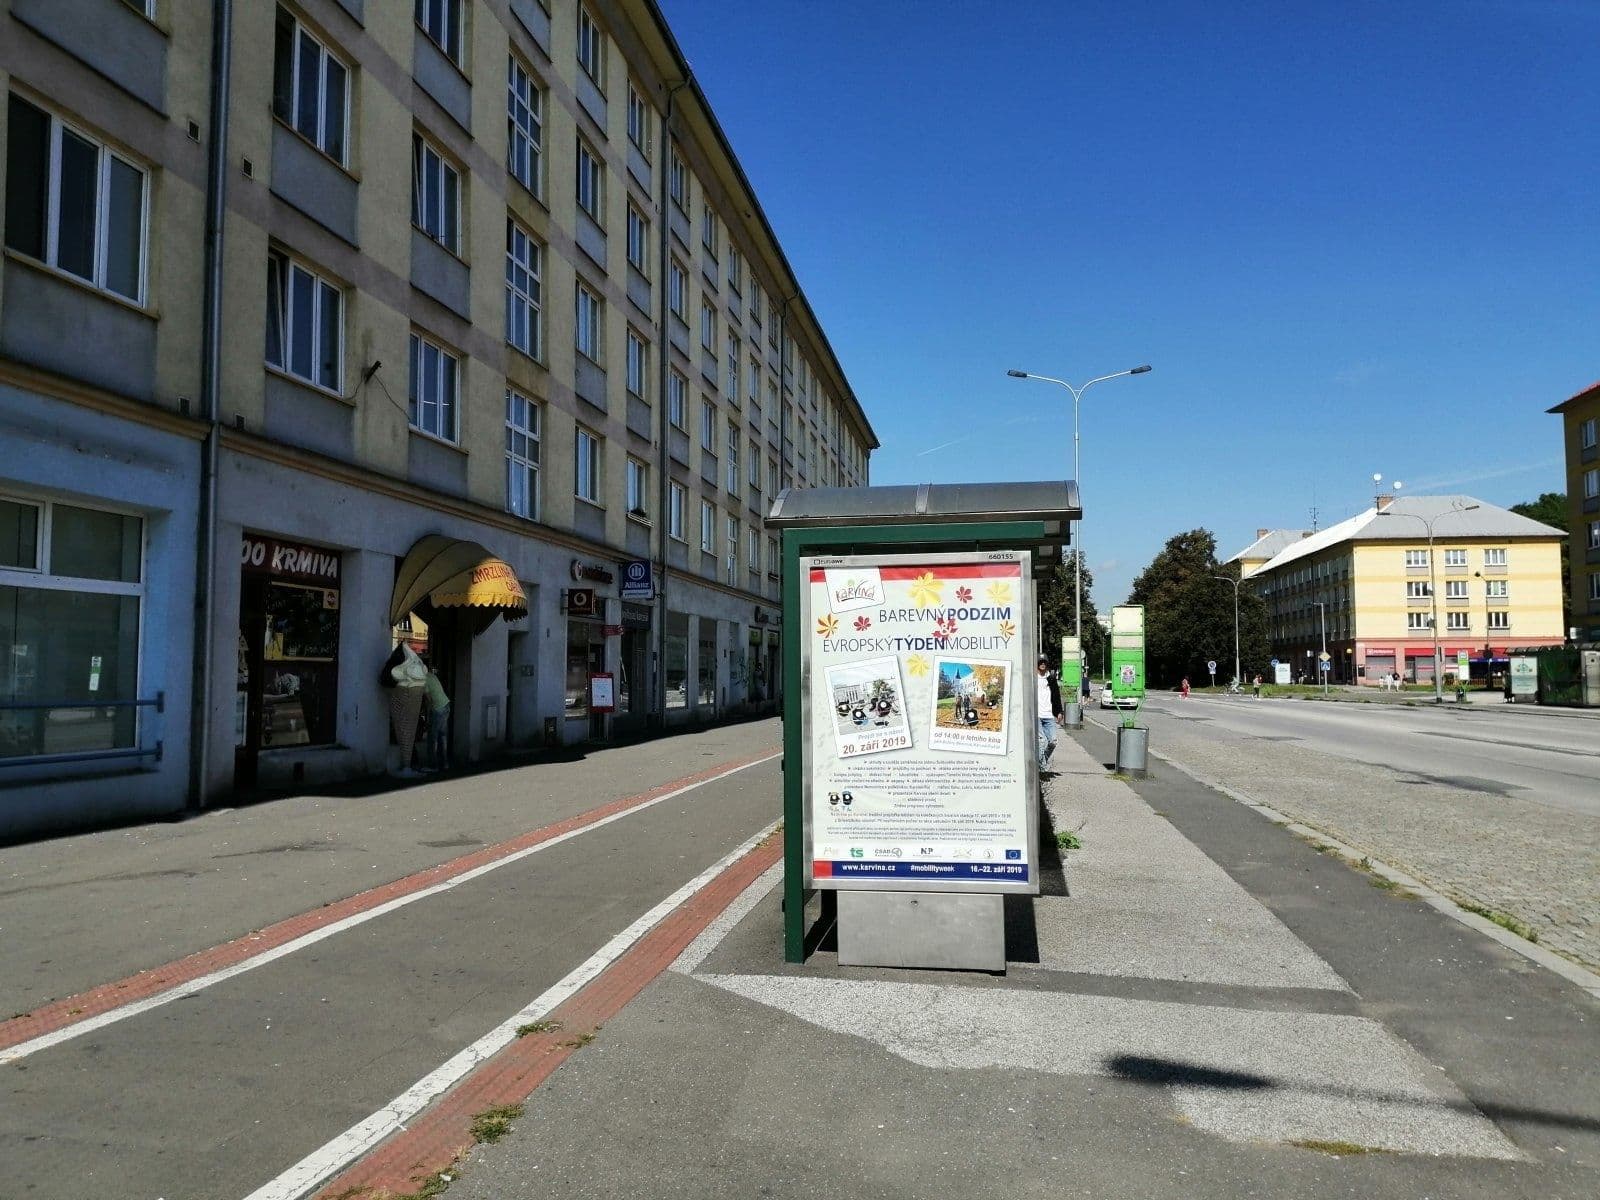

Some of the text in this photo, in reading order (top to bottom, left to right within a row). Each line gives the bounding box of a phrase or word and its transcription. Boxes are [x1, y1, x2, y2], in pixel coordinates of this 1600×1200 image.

[272, 545, 338, 578] KRMIVA
[624, 581, 650, 589] Allianz
[843, 735, 906, 754] 20. září 2019
[849, 847, 864, 858] ts
[1006, 866, 1023, 874] 2019
